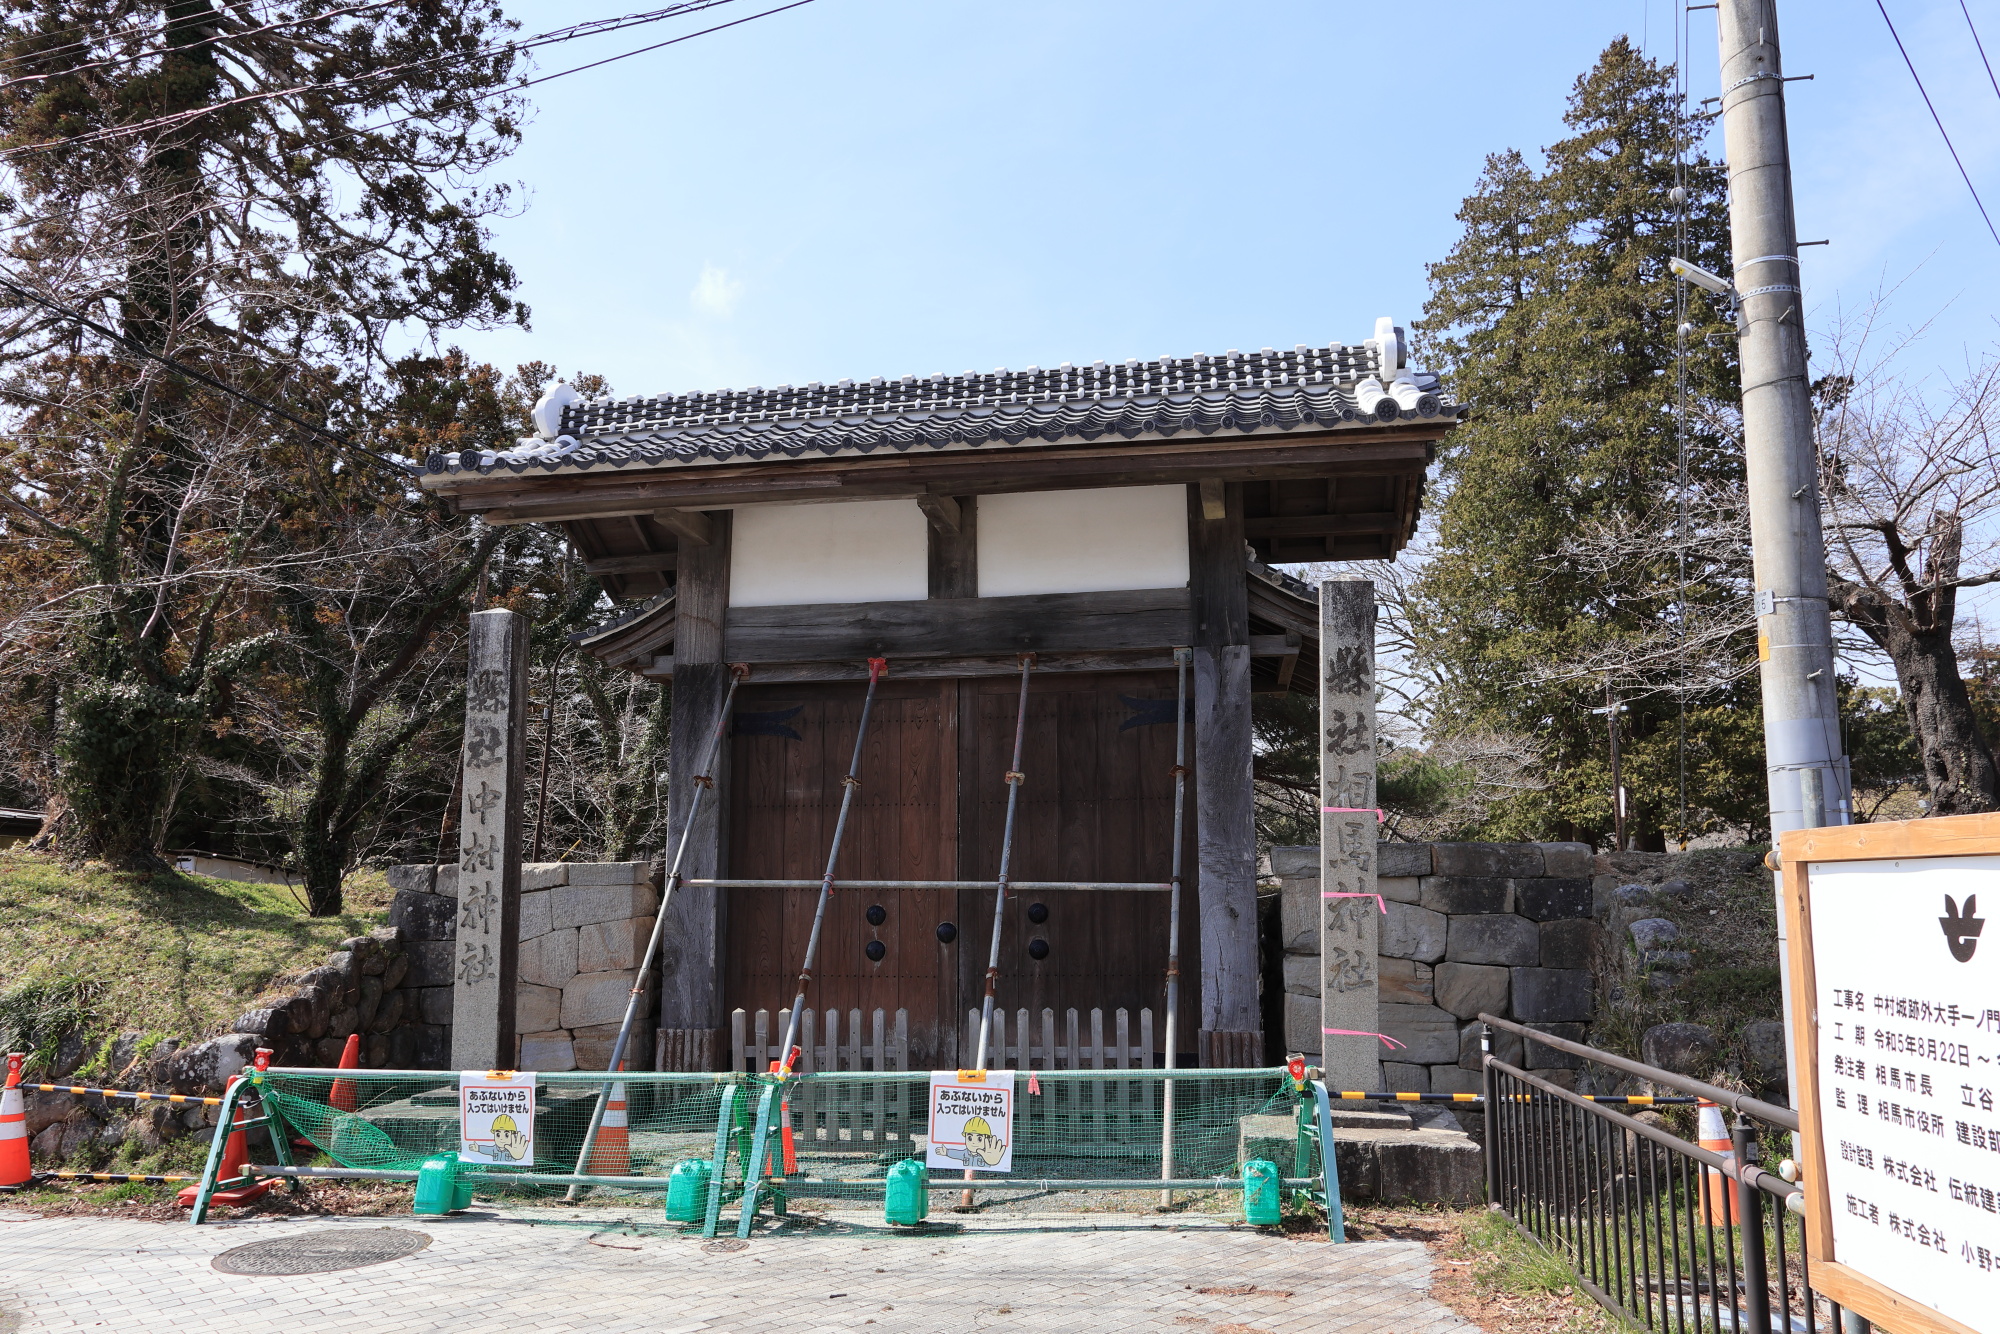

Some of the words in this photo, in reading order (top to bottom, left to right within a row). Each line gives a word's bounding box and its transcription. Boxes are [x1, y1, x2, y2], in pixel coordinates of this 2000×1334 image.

[1833, 988, 1864, 1012] 工事名
[1834, 1054, 1866, 1081] 発注者
[1875, 1063, 1933, 1097] 相馬市長
[1960, 1083, 1994, 1112] 立谷
[469, 1091, 526, 1101] あぶないから
[940, 1090, 1003, 1104] あぶないから
[467, 1103, 529, 1114] 入ってはいけません
[936, 1103, 1006, 1117] 入ってはいけません
[1878, 1099, 1944, 1138] 相馬市役所
[1840, 1139, 1874, 1170] 設計監理
[1883, 1155, 1938, 1193] 株式会社
[1949, 1177, 2000, 1214] 伝統建
[1846, 1192, 1879, 1226] 施工者
[1889, 1211, 1948, 1254] 株式会社
